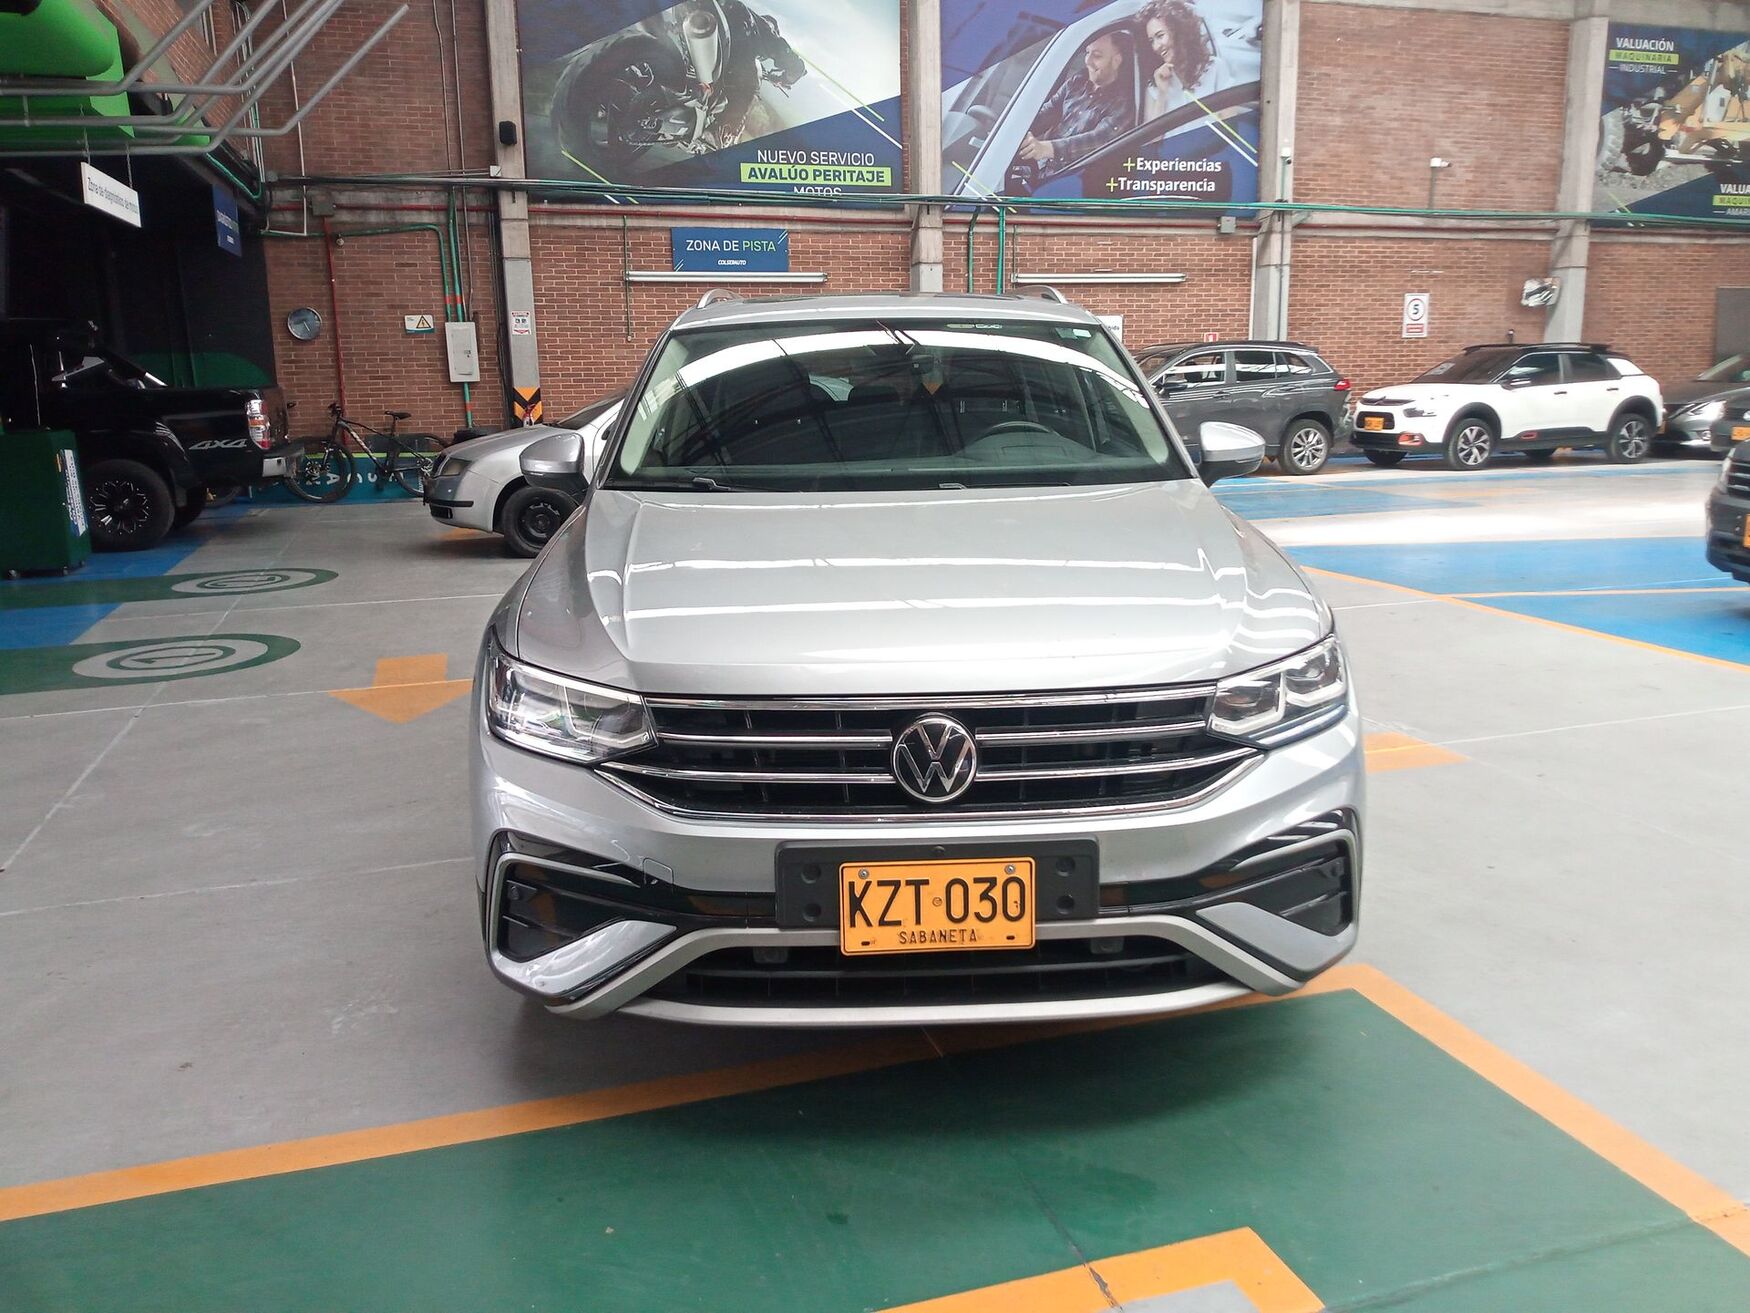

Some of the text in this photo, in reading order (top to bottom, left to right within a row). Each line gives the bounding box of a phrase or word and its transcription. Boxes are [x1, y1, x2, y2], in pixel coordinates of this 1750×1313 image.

[1615, 37, 1675, 51] VALUACIÓN
[1619, 63, 1667, 74] INDUSTRIAL
[757, 149, 875, 166] NUEVO SERVICIO
[748, 165, 885, 183] AVALÚO PERITAJE
[686, 240, 777, 252] ZONA DE PISTA
[1412, 303, 1420, 315] 5
[848, 879, 930, 928] KZT
[899, 928, 978, 945] SABANETA
